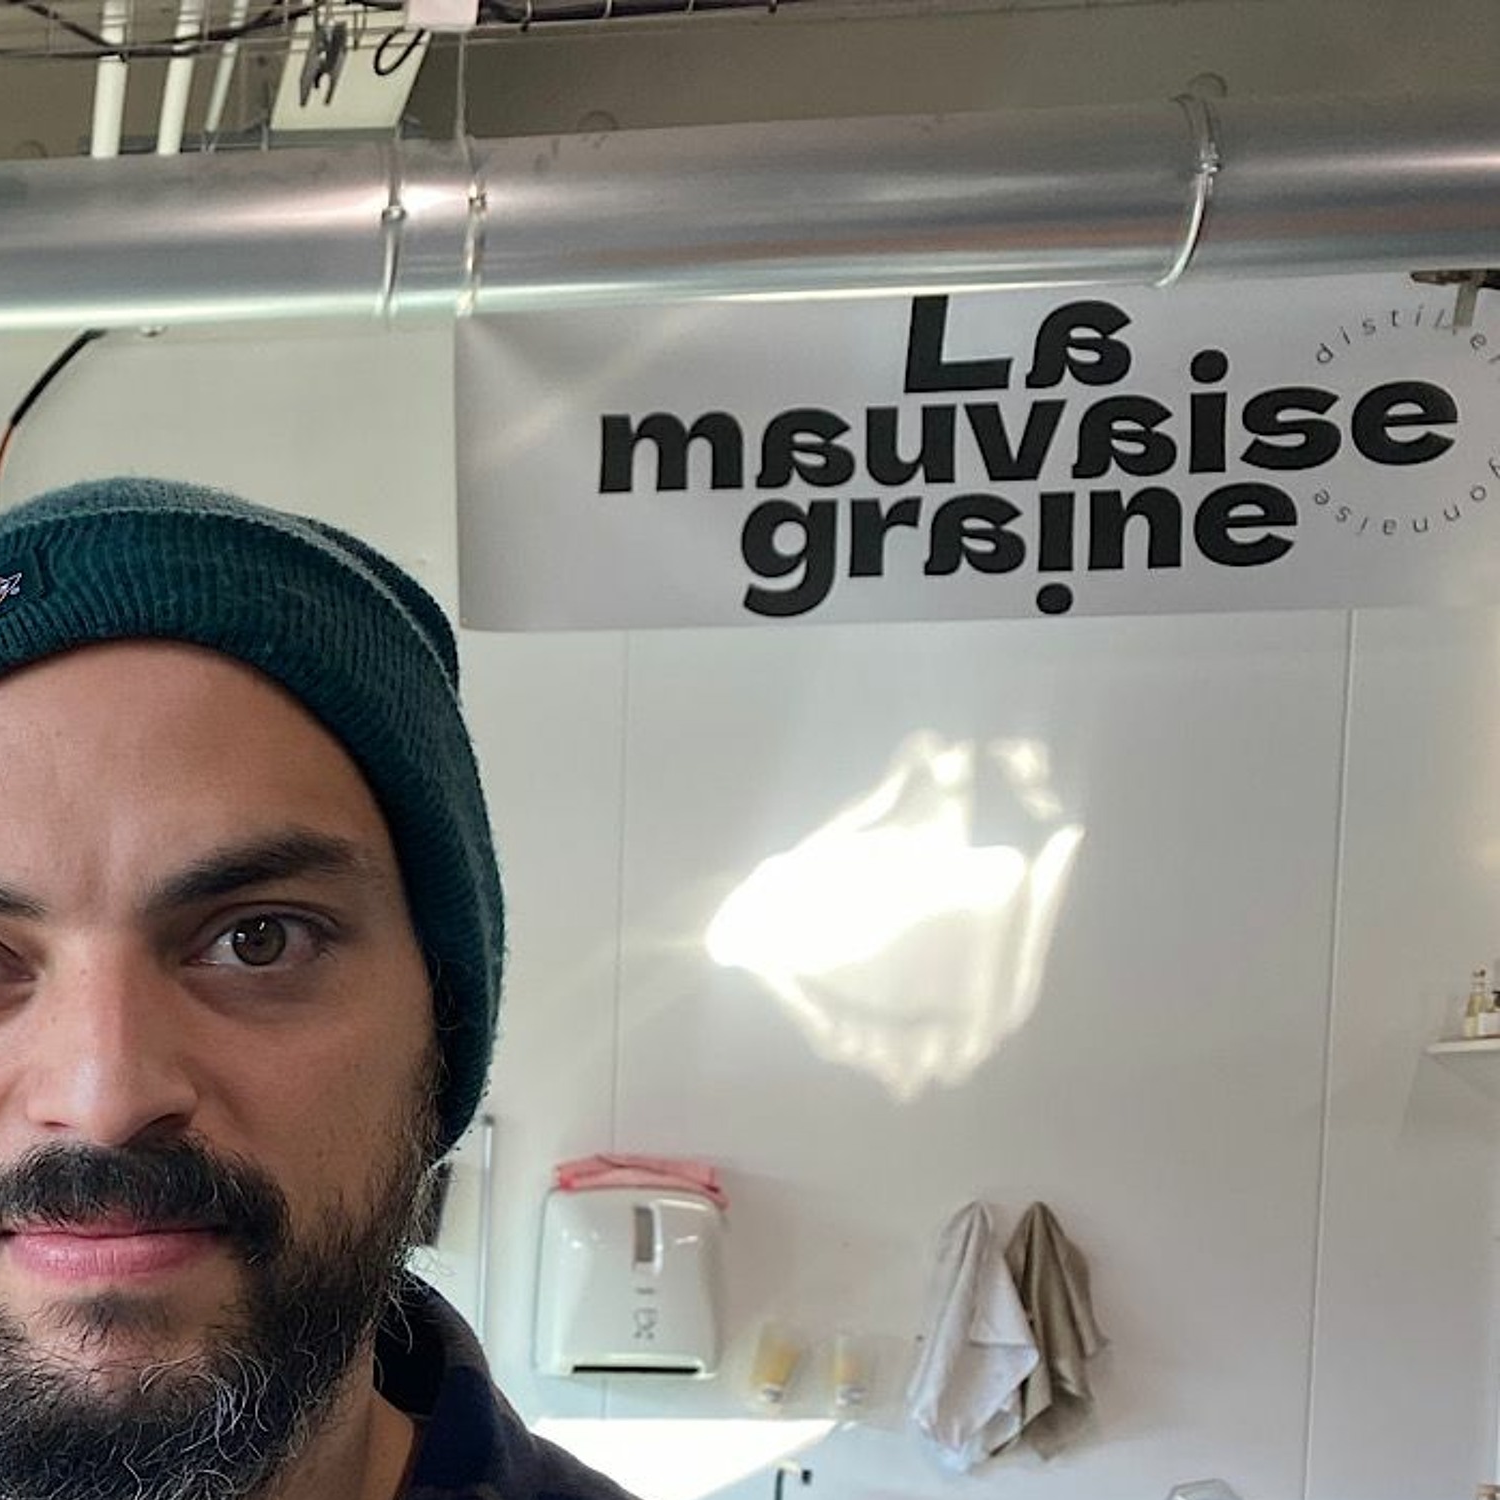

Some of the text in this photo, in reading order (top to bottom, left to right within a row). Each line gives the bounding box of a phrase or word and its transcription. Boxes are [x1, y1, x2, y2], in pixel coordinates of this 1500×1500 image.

[903, 294, 1132, 394] La
[598, 350, 1458, 494] mauvaise
[740, 483, 1298, 618] graine
